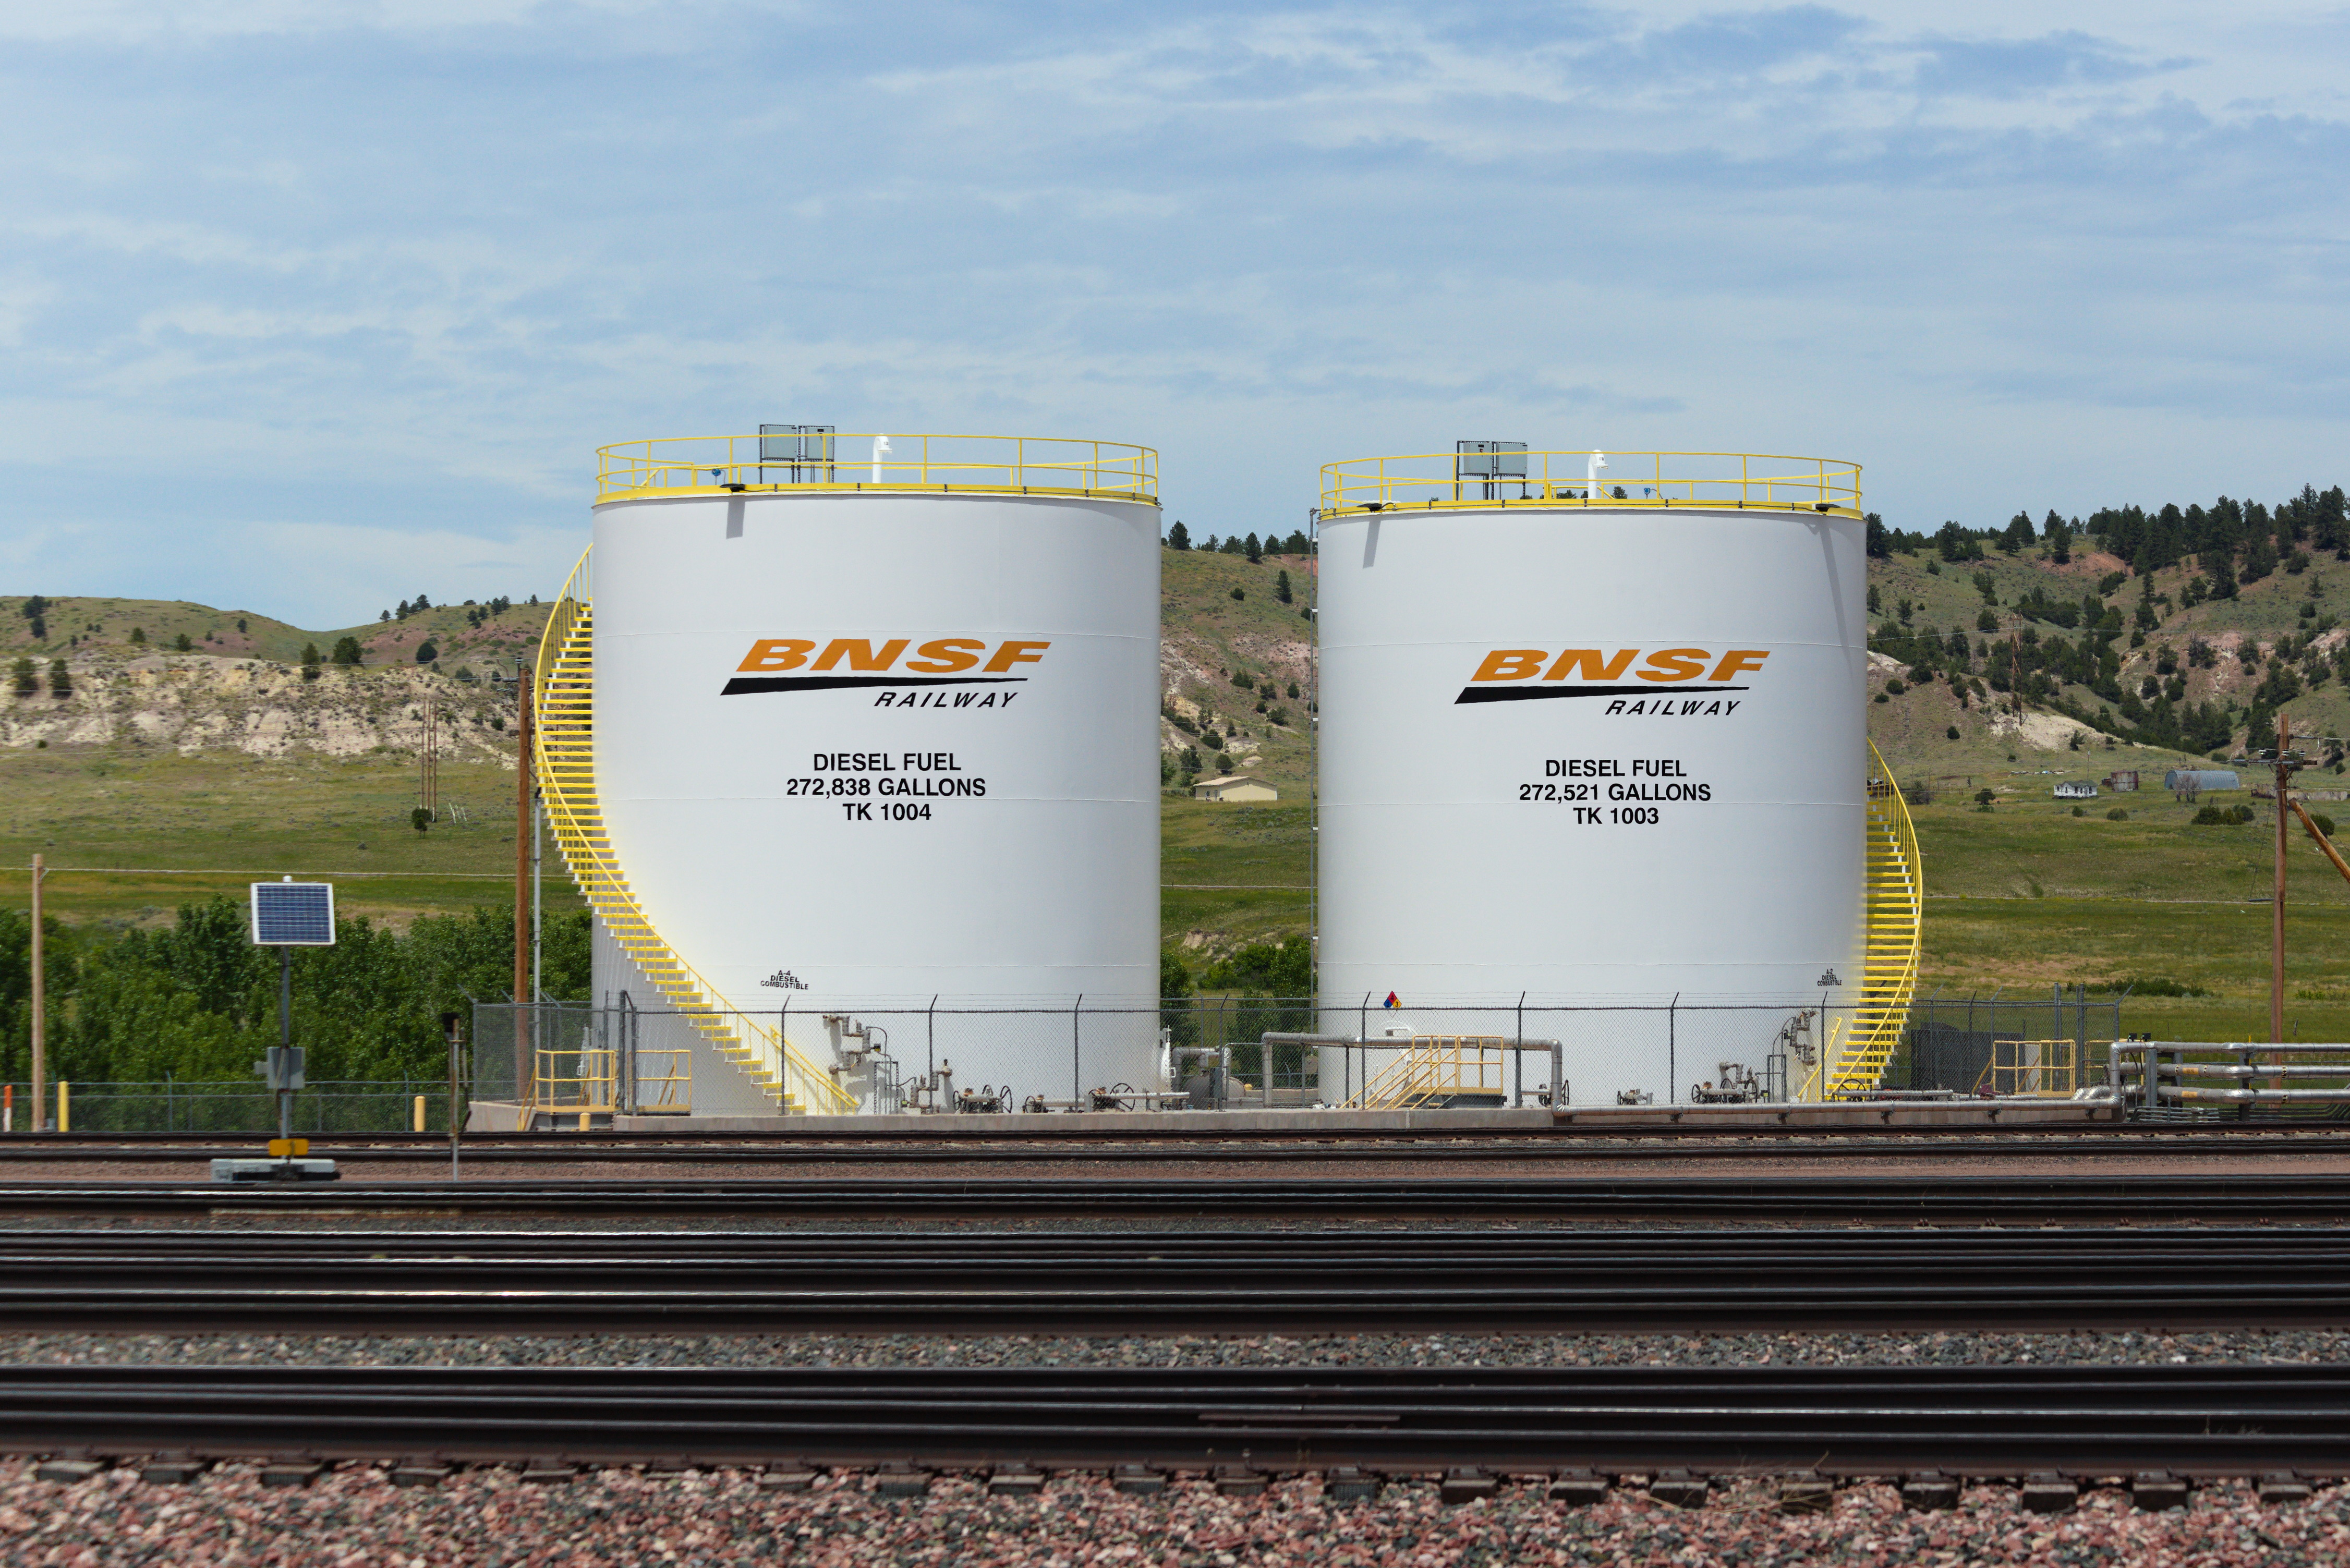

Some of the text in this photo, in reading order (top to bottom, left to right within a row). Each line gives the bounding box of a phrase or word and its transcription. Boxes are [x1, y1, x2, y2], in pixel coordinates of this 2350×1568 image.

[736, 638, 1051, 673] BNSF
[1470, 648, 1771, 682] BNSF
[874, 691, 1018, 708] RAILWAY
[1605, 700, 1741, 716] RAILWAY
[814, 752, 962, 771] DIESEL FUEL
[1546, 759, 1687, 777] DIESEL FUEL
[786, 777, 986, 799] 272,838 GALLONS
[1519, 783, 1711, 804] 272,521 GALLONS
[842, 803, 931, 821] TK 1004
[1573, 807, 1659, 824] TK 1003
[760, 980, 809, 990] COMBUSTIBLE
